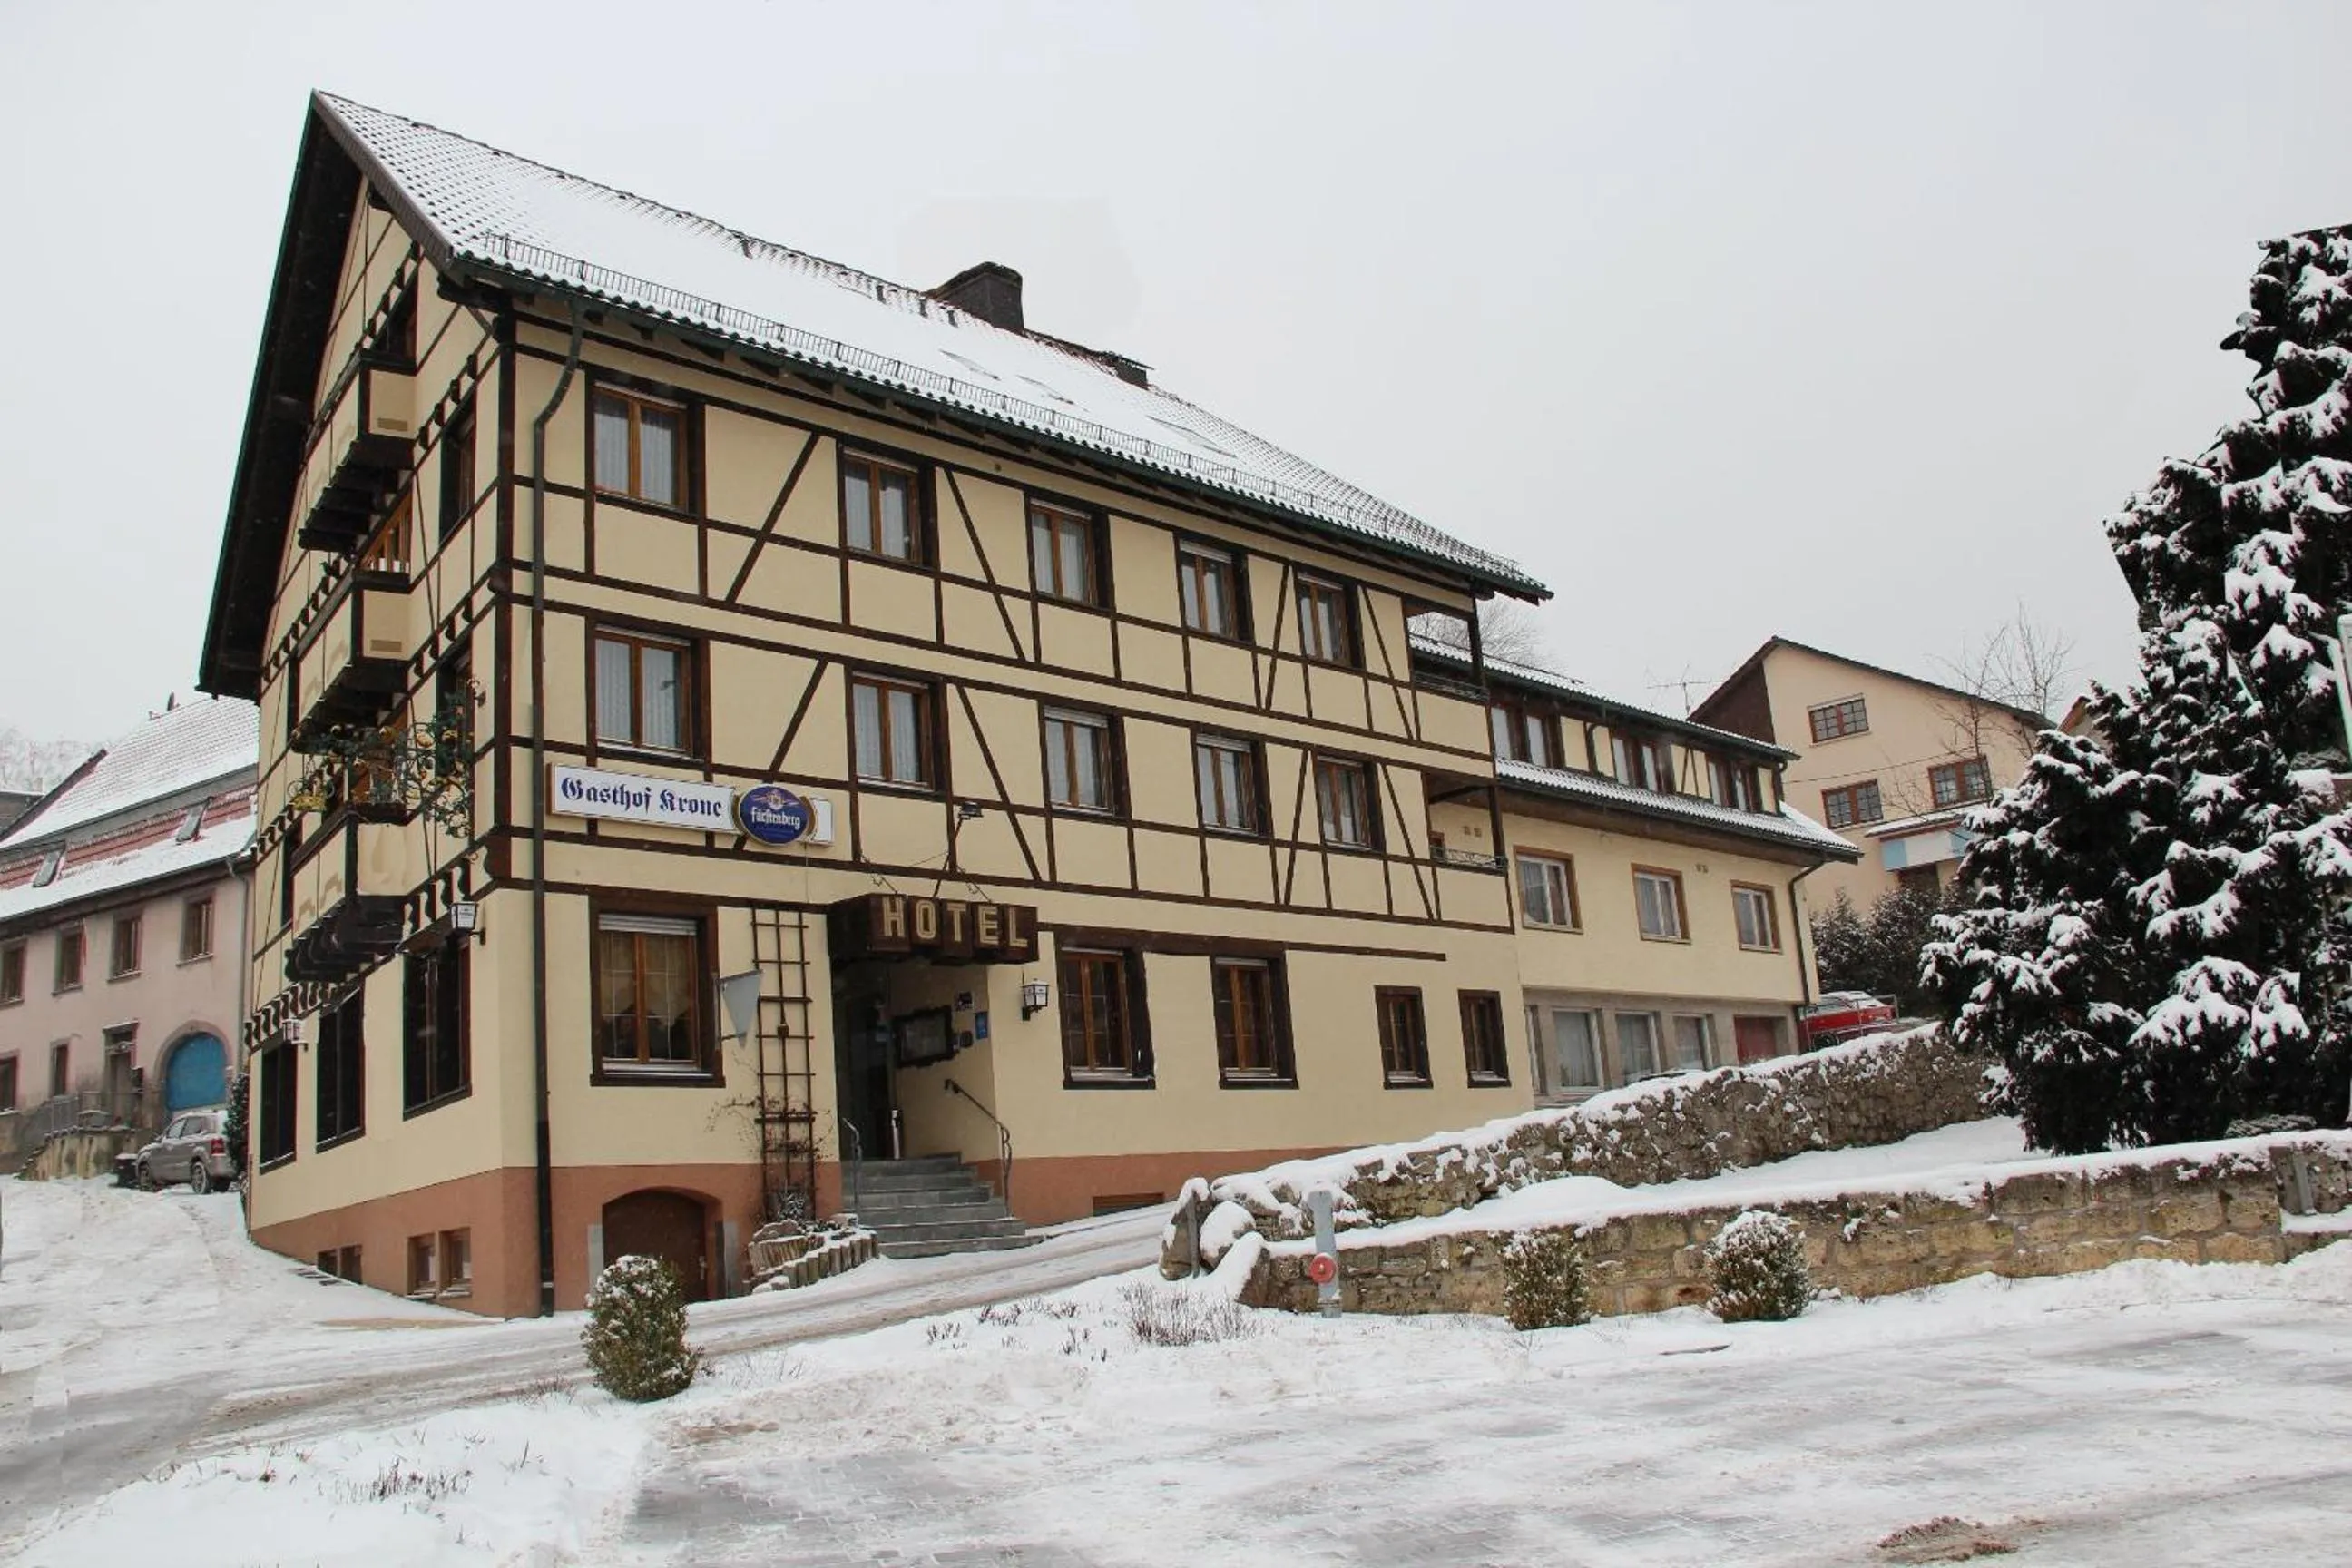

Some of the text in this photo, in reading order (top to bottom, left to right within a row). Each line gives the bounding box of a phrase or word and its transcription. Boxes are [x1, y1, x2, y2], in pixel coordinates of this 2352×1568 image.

[561, 777, 722, 817] Gasthof Krone
[882, 897, 1028, 947] HOTEL
